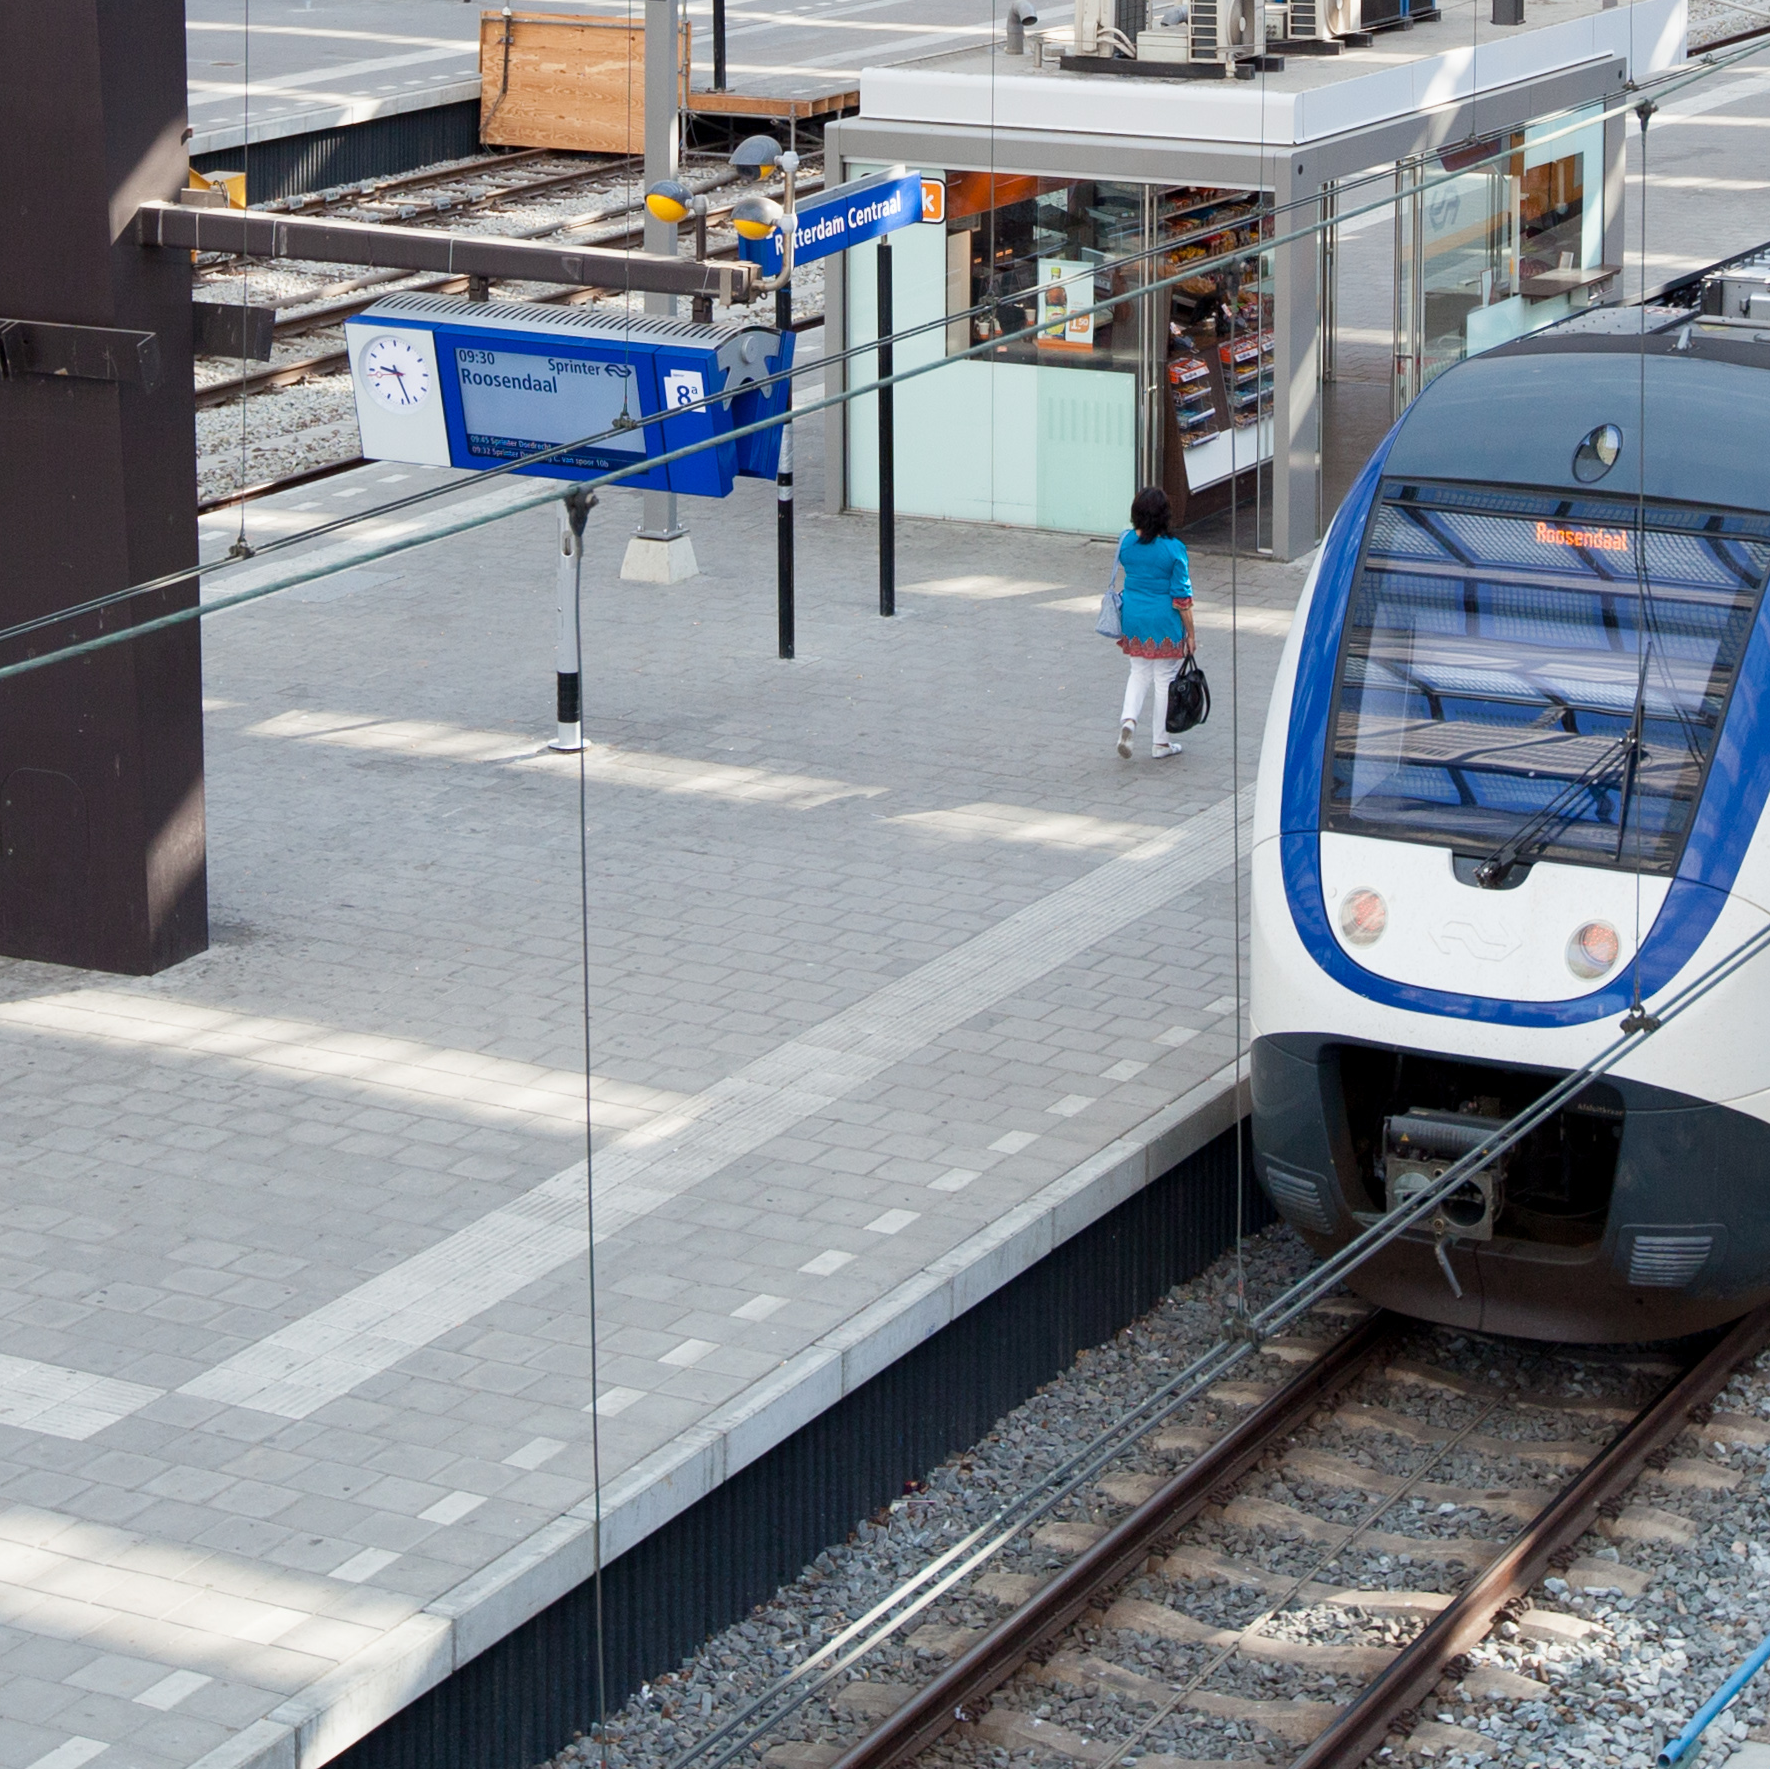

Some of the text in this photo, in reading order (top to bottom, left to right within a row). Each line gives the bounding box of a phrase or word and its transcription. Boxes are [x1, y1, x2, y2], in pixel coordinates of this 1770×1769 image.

[775, 215, 845, 256] Rtterdam
[847, 190, 902, 229] Centraal
[458, 349, 601, 375] 09:30 Sprinter
[461, 368, 558, 393] Roosendaal
[491, 436, 517, 447] Sprinter
[492, 447, 518, 458] Sprinter
[575, 458, 594, 466] spoor
[1536, 521, 1628, 551] Roosendaal
